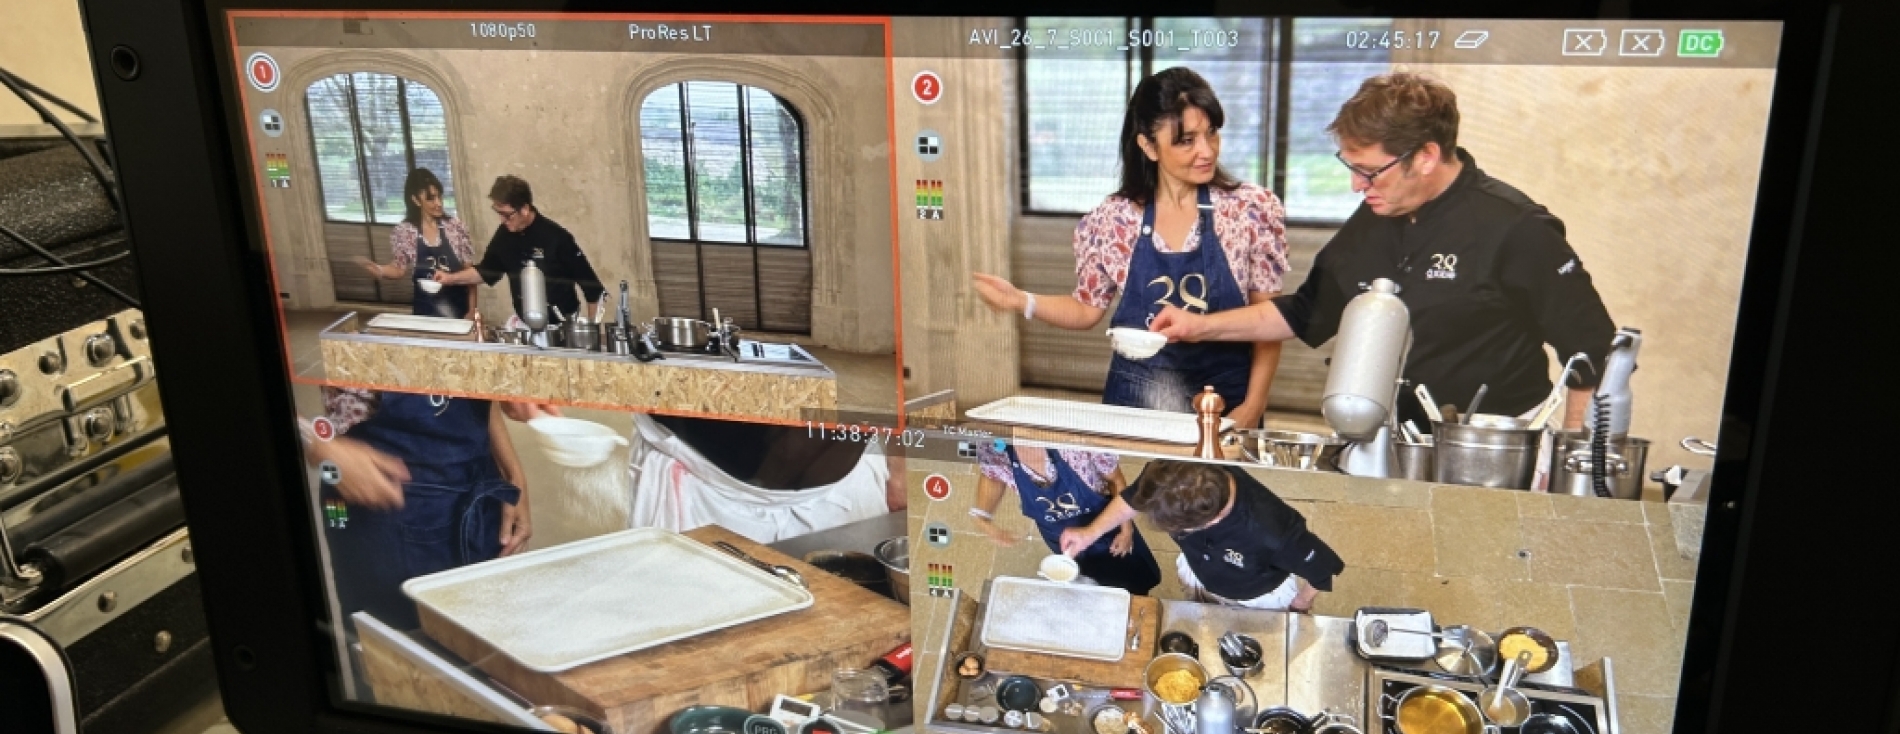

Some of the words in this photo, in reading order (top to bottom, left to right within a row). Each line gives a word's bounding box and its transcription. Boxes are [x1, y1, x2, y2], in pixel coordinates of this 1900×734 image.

[470, 22, 536, 41] 1080p50
[628, 24, 689, 40] ProRes
[693, 25, 712, 41] LT
[1346, 31, 1440, 49] 02:45:17
[1685, 34, 1714, 52] DC
[806, 421, 925, 448] 11:38:37:02
